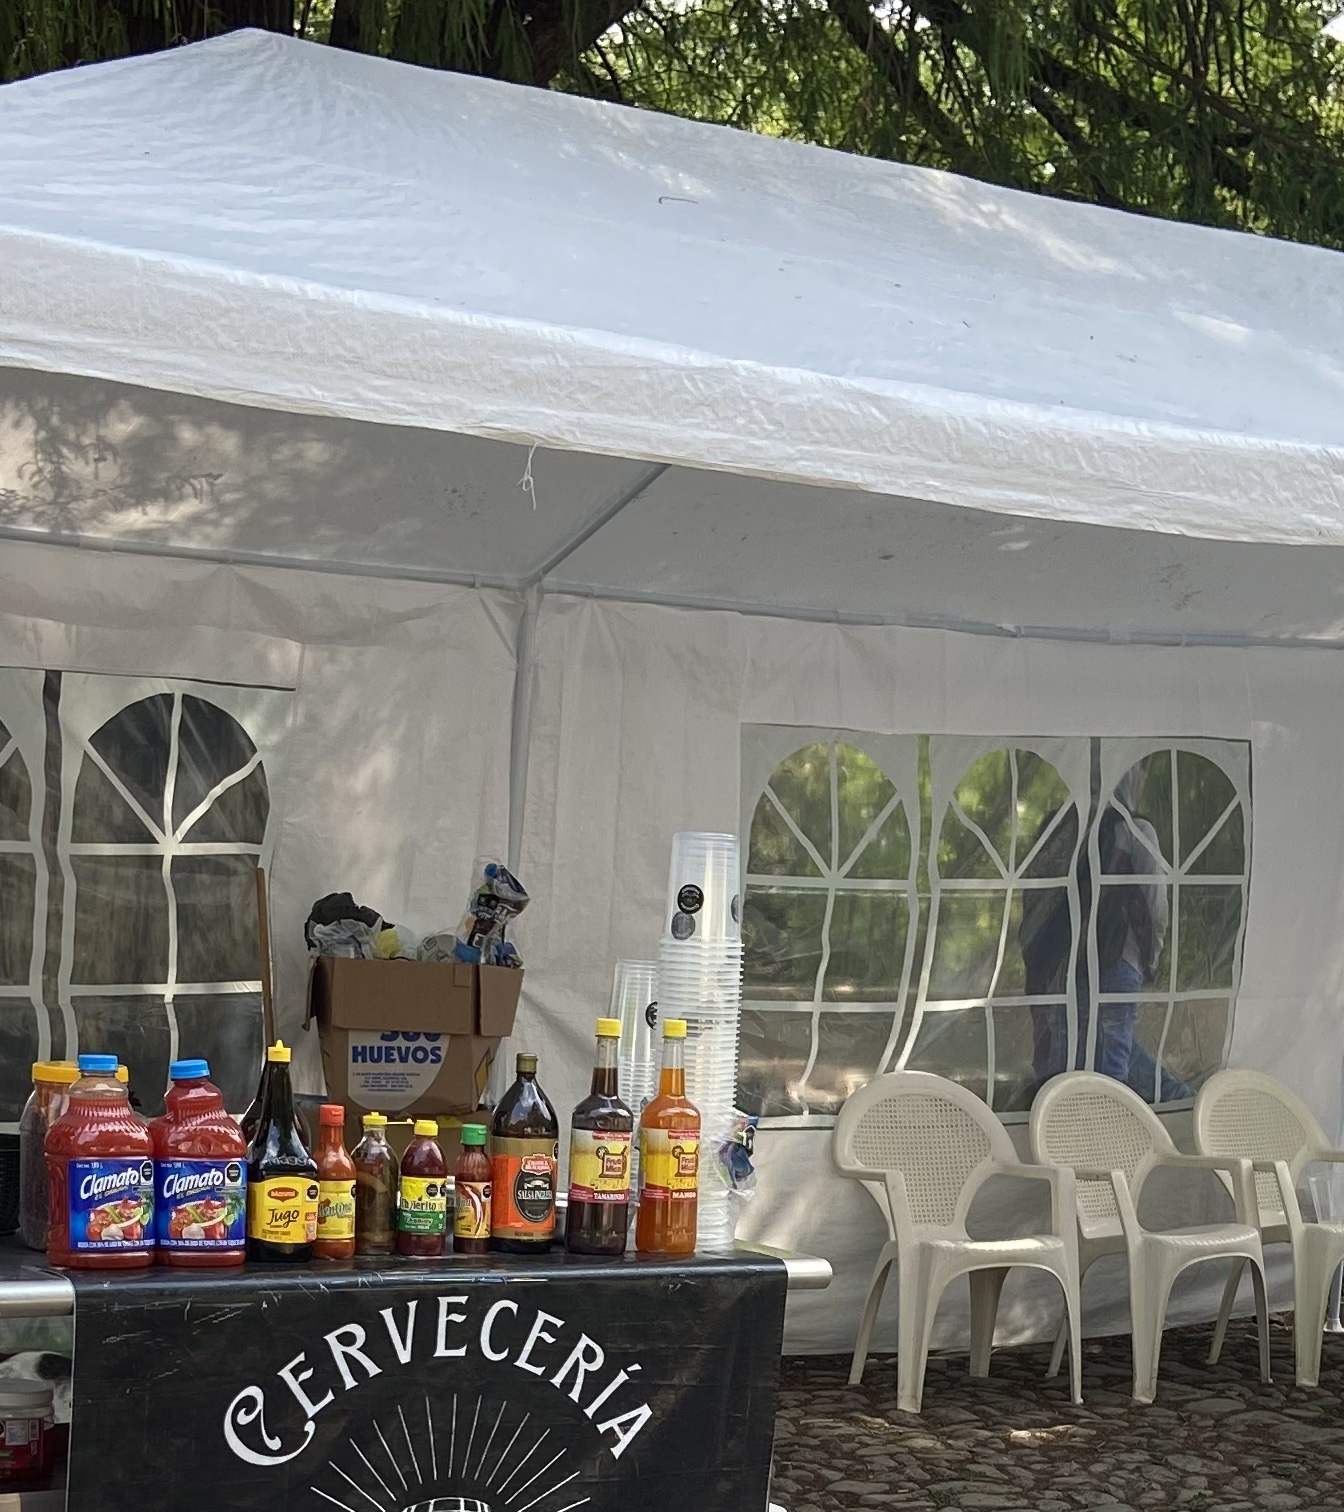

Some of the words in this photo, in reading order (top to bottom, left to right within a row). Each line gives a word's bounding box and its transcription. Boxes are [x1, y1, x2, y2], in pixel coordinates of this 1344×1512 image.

[352, 1045, 442, 1065] HUEVOS
[80, 1167, 140, 1200] Clamato
[163, 1168, 224, 1199] Clamato
[265, 1207, 300, 1229] Jugo
[223, 1295, 654, 1466] CERVECERÍA
